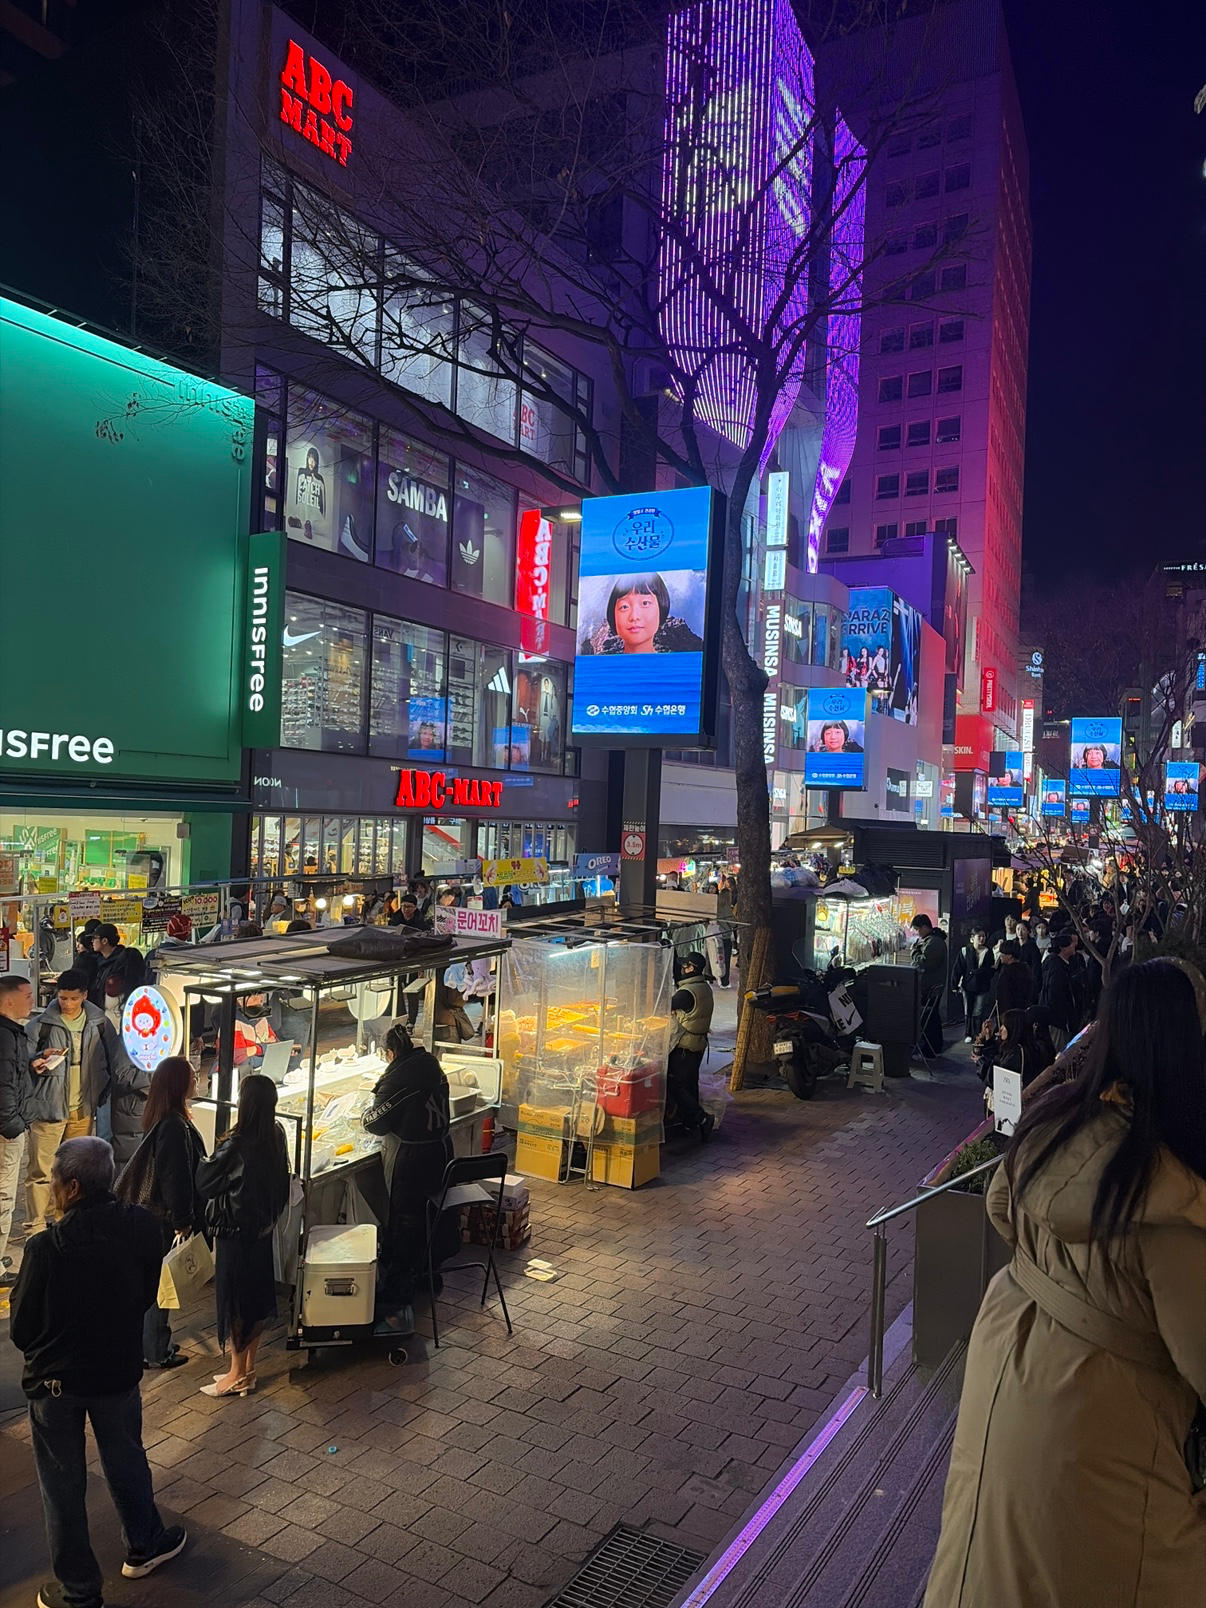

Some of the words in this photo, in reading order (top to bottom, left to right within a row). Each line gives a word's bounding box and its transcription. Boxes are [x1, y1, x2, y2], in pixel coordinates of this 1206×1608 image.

[281, 39, 353, 132] ABC
[280, 87, 353, 168] MART
[387, 471, 448, 522] SAMBA
[631, 520, 655, 535] 우리
[625, 535, 661, 551] 수산물
[1181, 562, 1206, 571] FRÉS
[763, 604, 781, 677] MUSINSA
[601, 705, 638, 715] 수협중앙회
[640, 704, 654, 715] Sh
[655, 704, 686, 715] 수협은행
[763, 692, 777, 764] MUSINSA
[395, 769, 503, 809] ABC-MART
[626, 841, 642, 849] 3.5m
[587, 855, 612, 870] OREO
[457, 911, 499, 933] 문어꼬치
